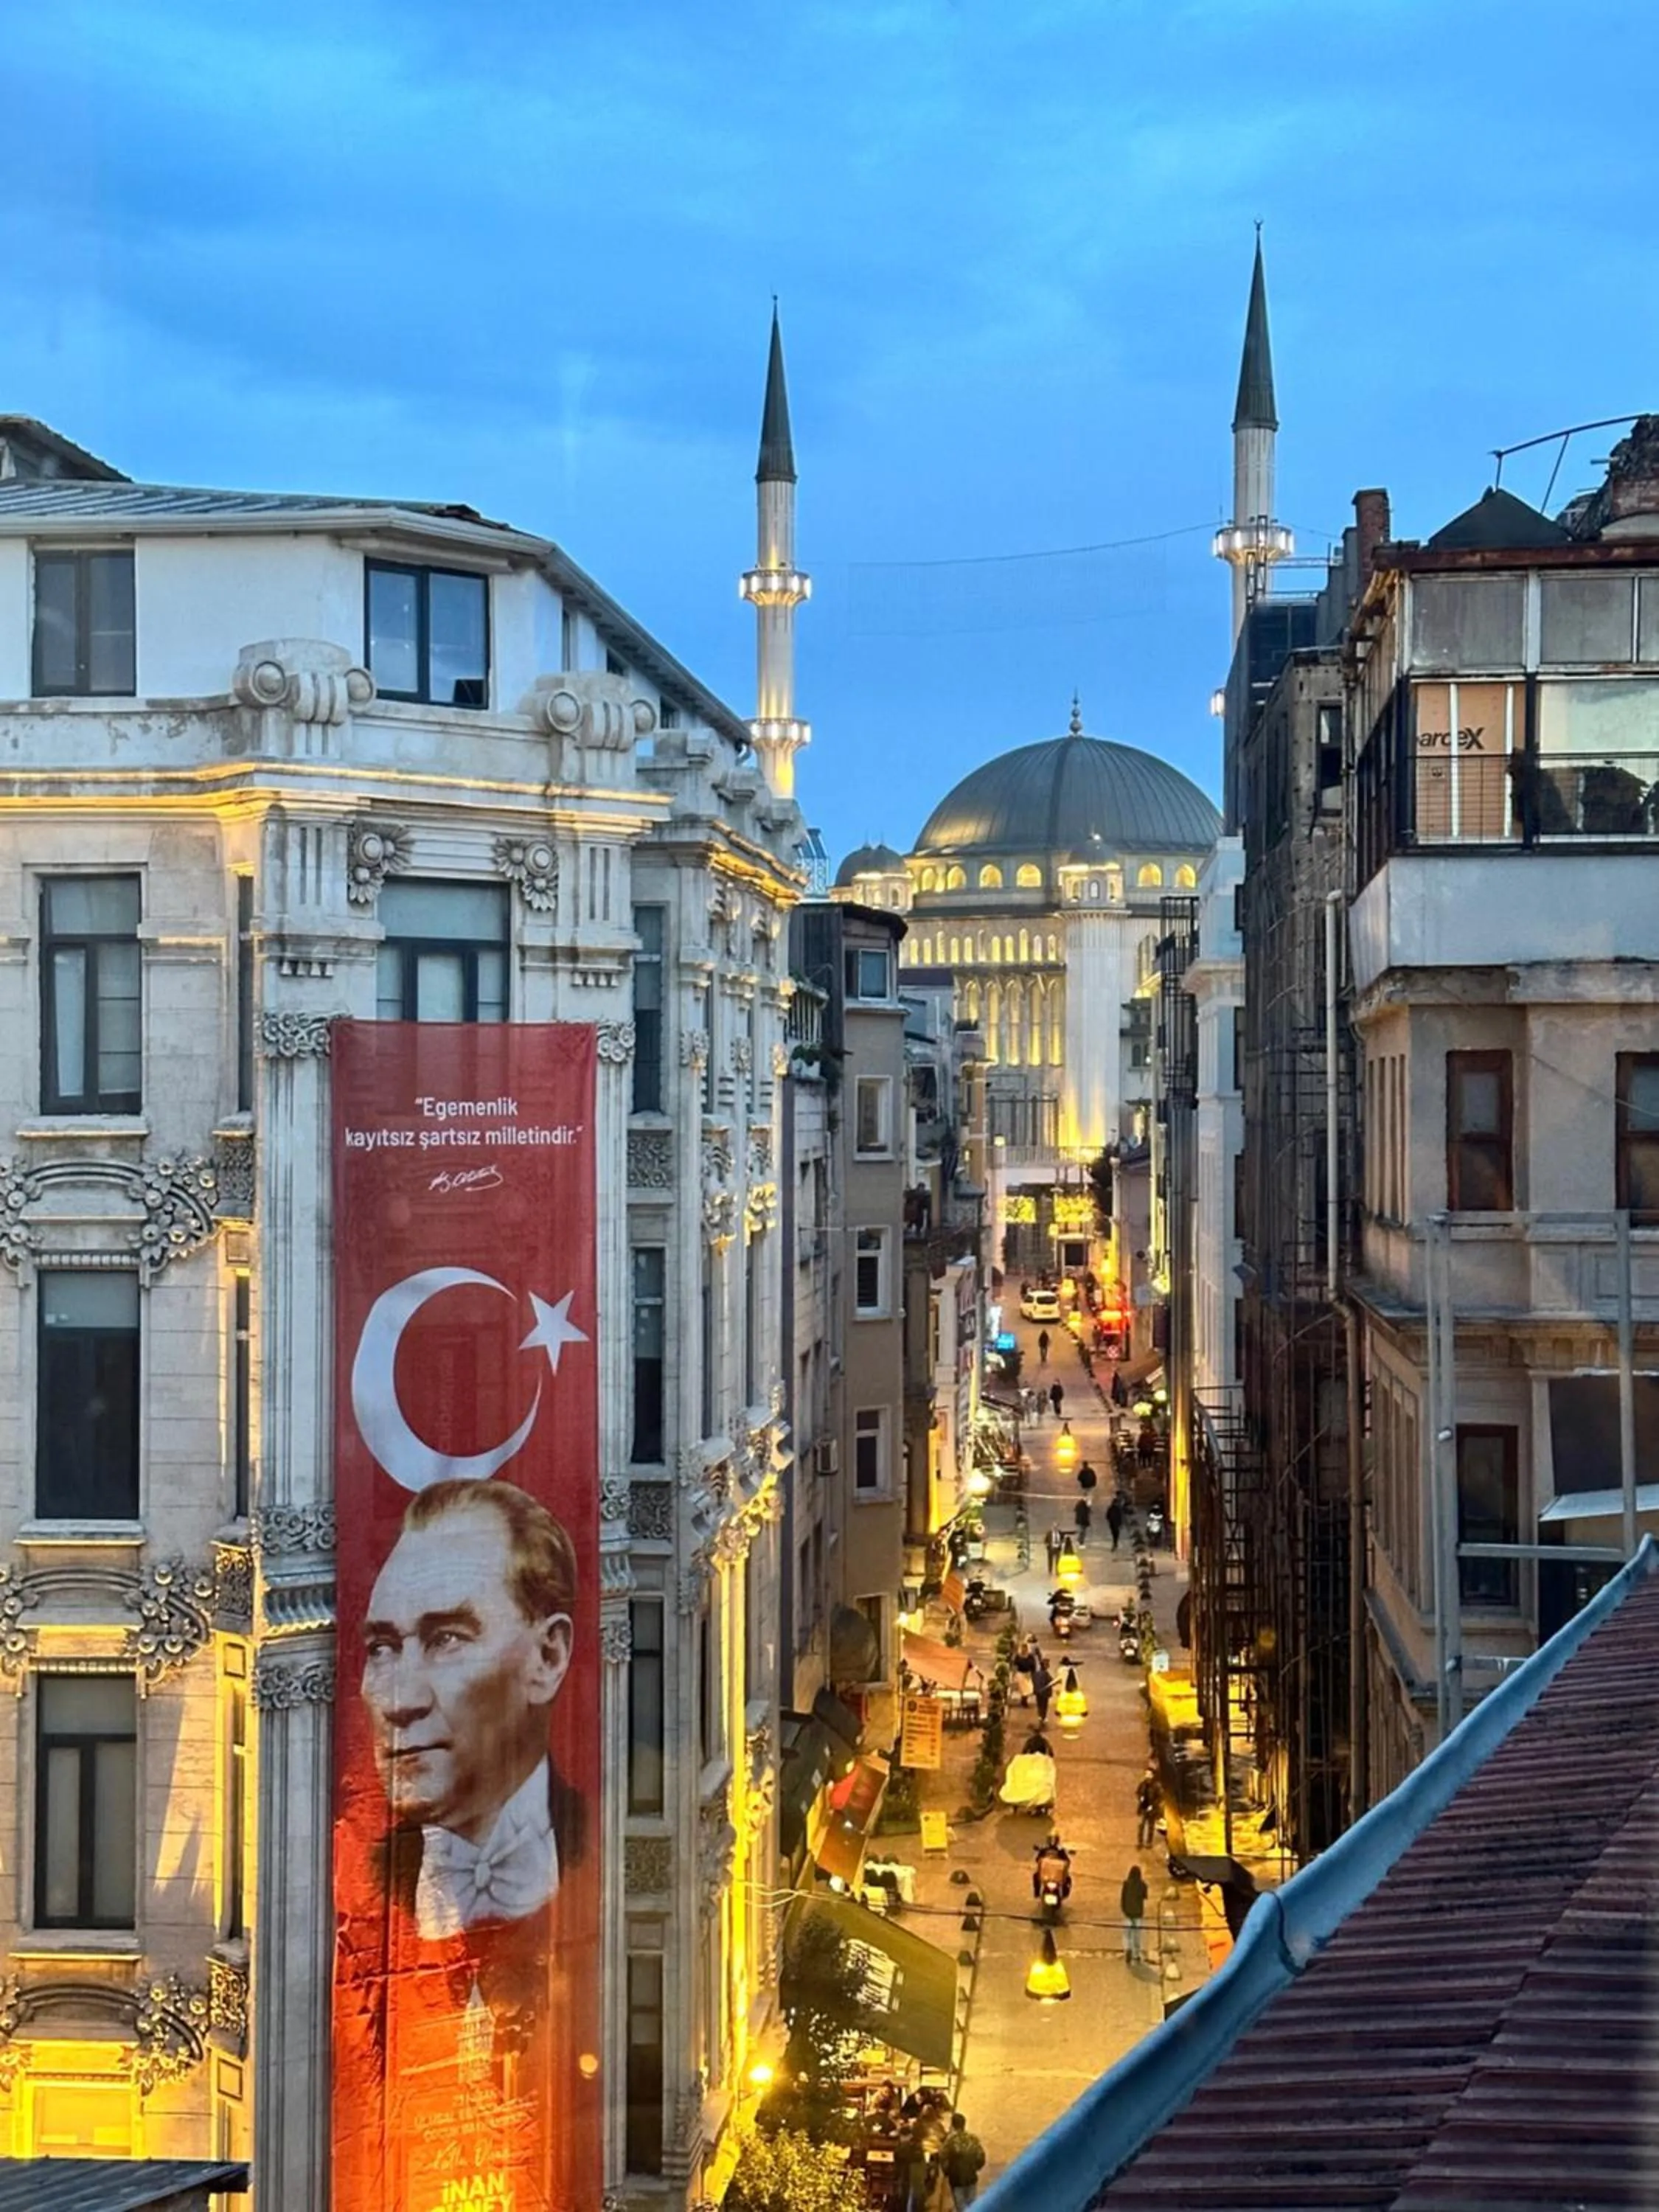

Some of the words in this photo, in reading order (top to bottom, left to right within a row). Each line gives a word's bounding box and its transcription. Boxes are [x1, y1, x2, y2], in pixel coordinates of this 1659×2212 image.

[414, 1096, 518, 1121] "Egemenlik
[344, 1127, 415, 1152] kayıtsız
[418, 1127, 481, 1151] şartsız
[485, 1125, 584, 1145] milletindir."
[442, 2170, 506, 2205] İNAN
[425, 2190, 515, 2212] NEY
